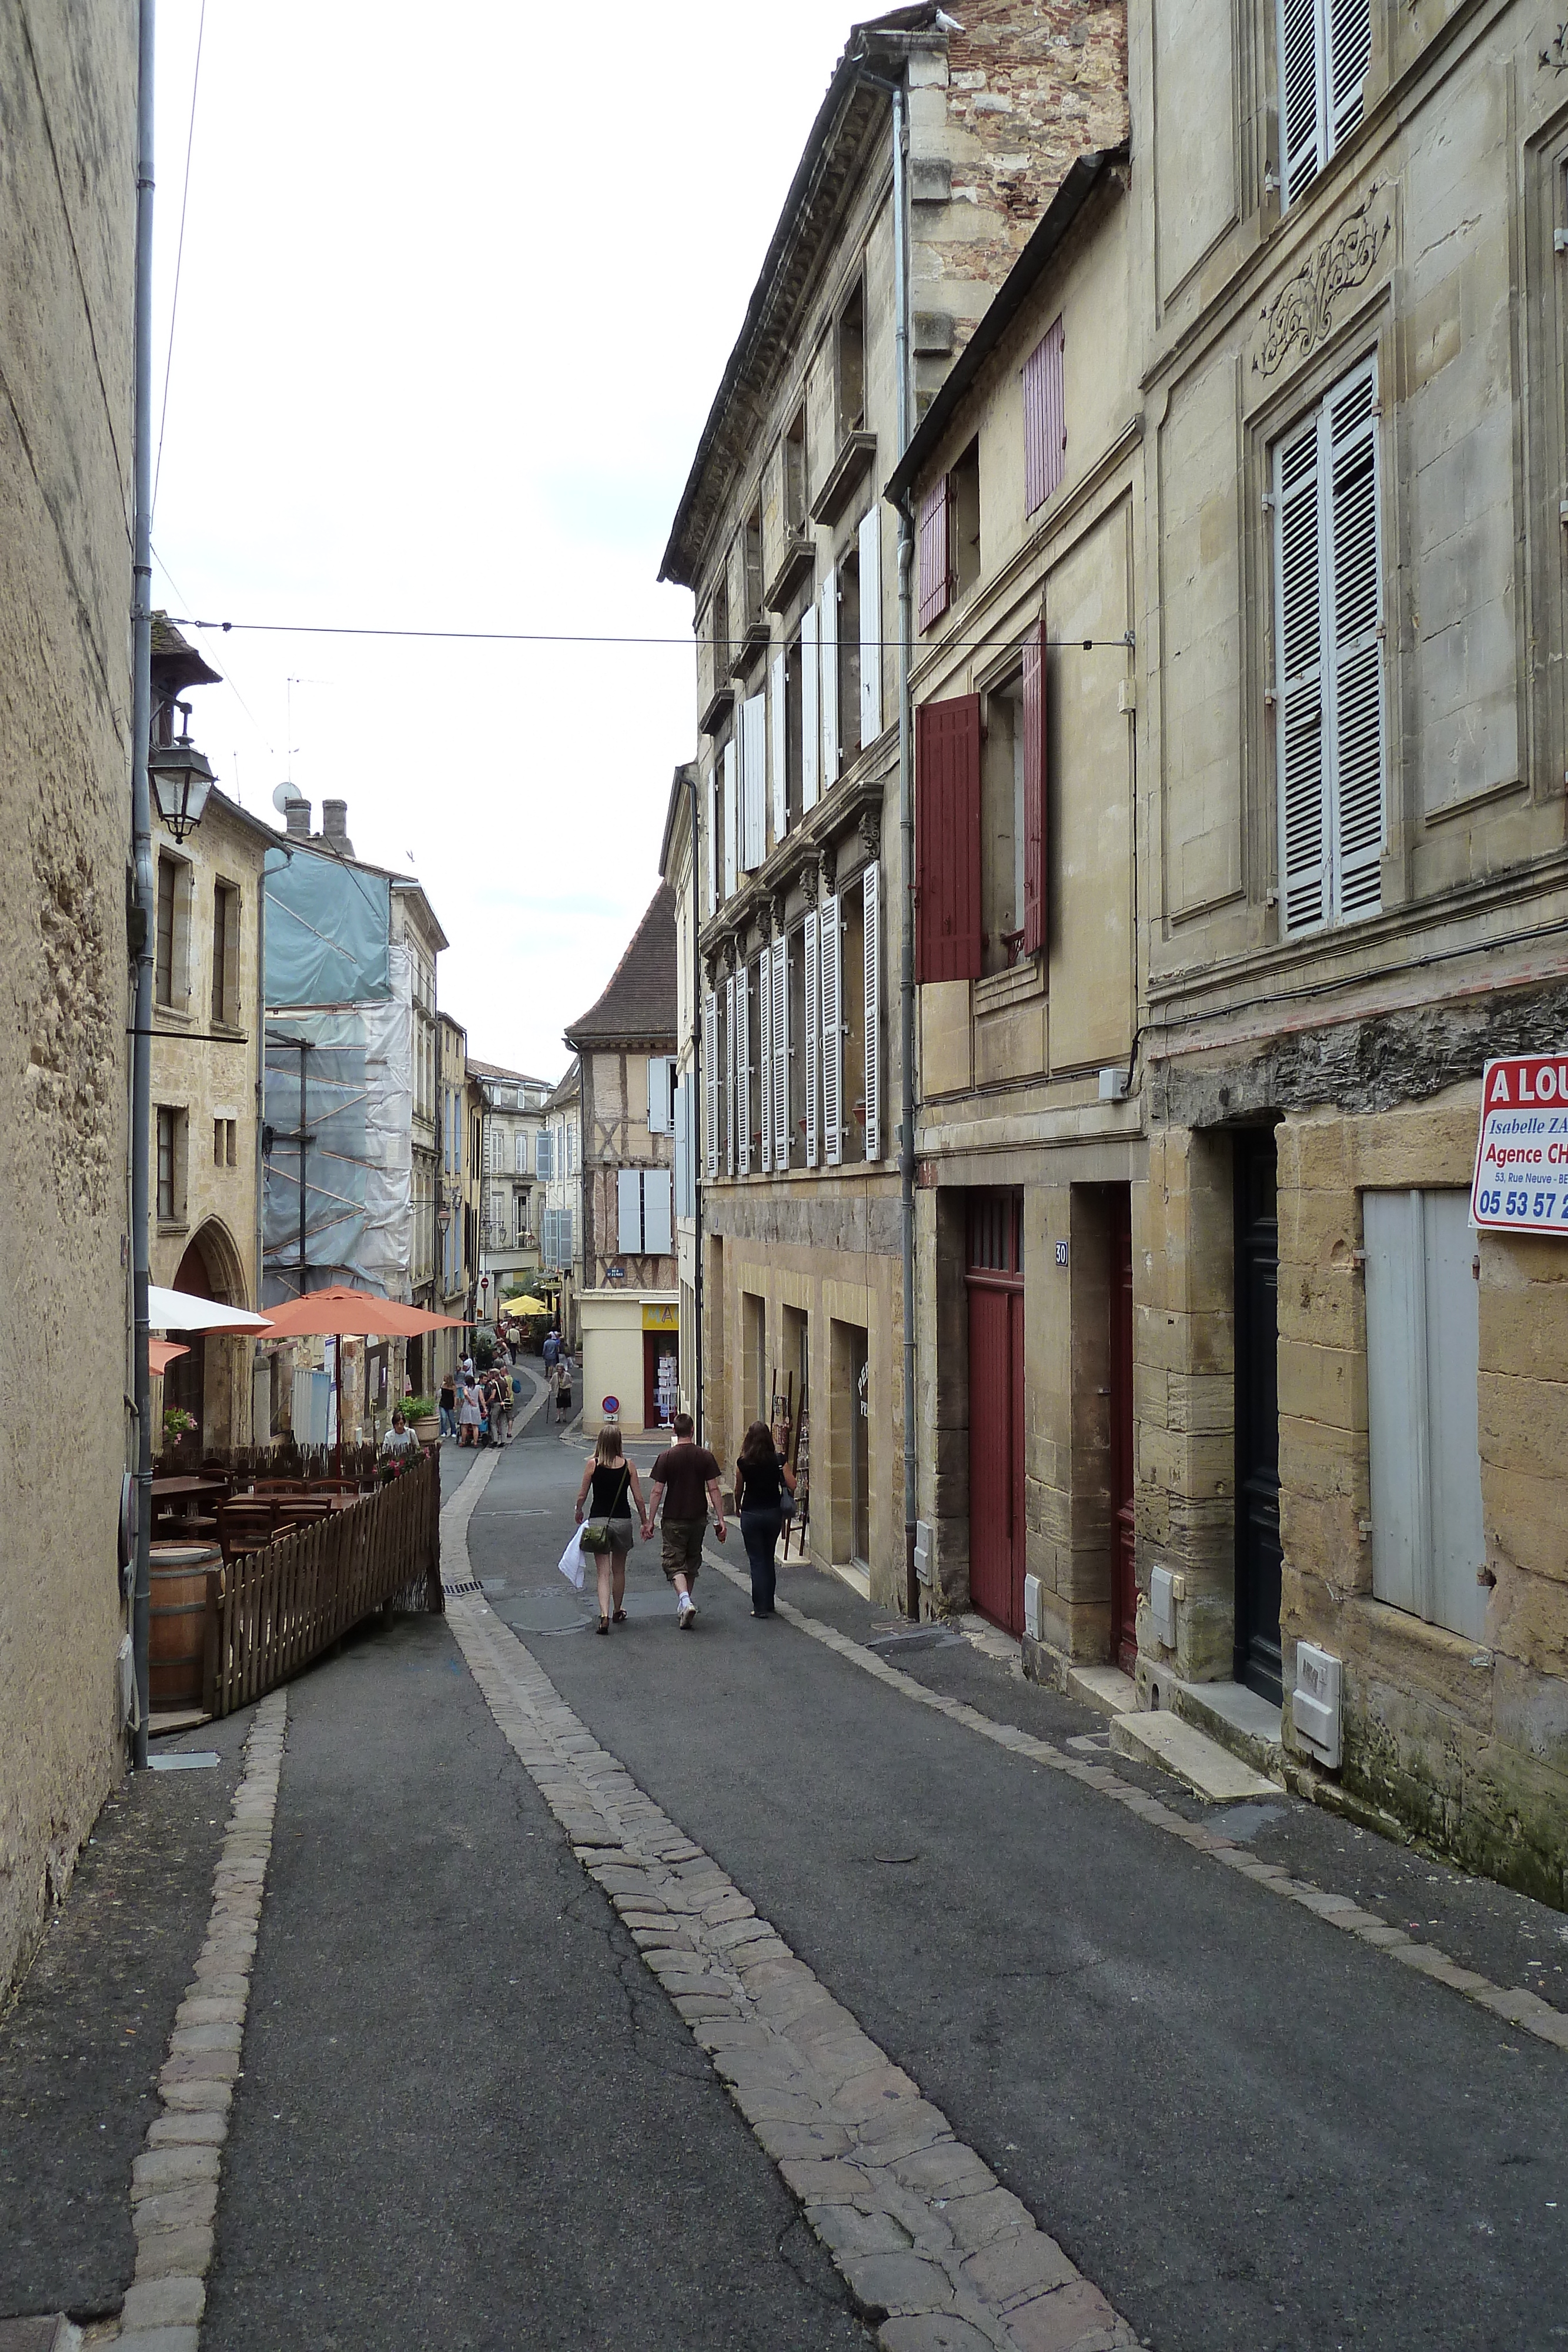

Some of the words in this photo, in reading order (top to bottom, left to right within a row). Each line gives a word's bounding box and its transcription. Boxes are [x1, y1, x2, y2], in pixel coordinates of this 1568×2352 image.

[1490, 1070, 1510, 1102] A
[1489, 1117, 1545, 1134] Isabelle
[1485, 1142, 1543, 1168] Agence
[1495, 1172, 1506, 1183] 53,
[1508, 1172, 1523, 1182] Rue
[1525, 1173, 1552, 1184] Neuve
[1479, 1190, 1501, 1214] 05
[1505, 1191, 1528, 1216] 53
[1533, 1192, 1556, 1218] 57
[1056, 1245, 1065, 1263] 30
